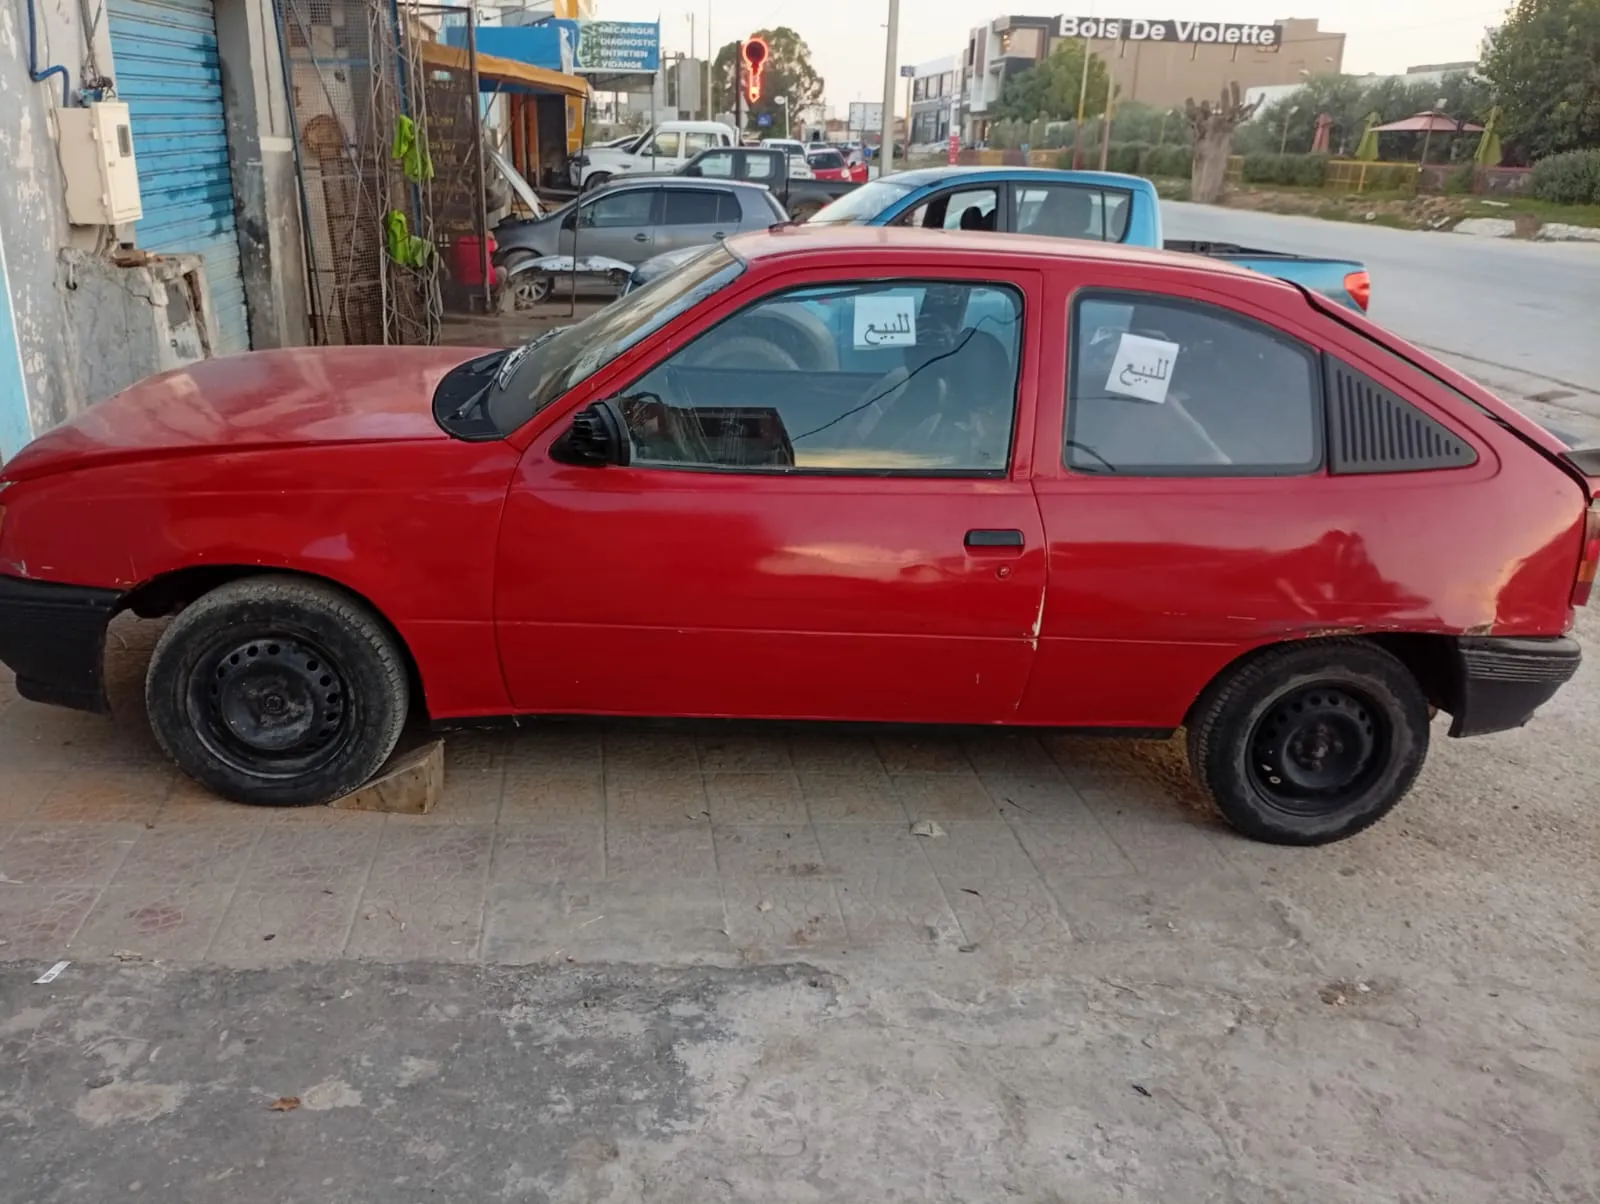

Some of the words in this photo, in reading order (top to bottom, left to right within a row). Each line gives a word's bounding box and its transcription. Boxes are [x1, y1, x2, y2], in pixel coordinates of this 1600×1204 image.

[600, 38, 656, 47] DIAGNOSTIC
[1059, 16, 1119, 39] Bois
[1129, 20, 1166, 40] De
[1175, 21, 1275, 45] Violette
[864, 313, 911, 345] للبيع
[1119, 358, 1169, 386] للبيع
